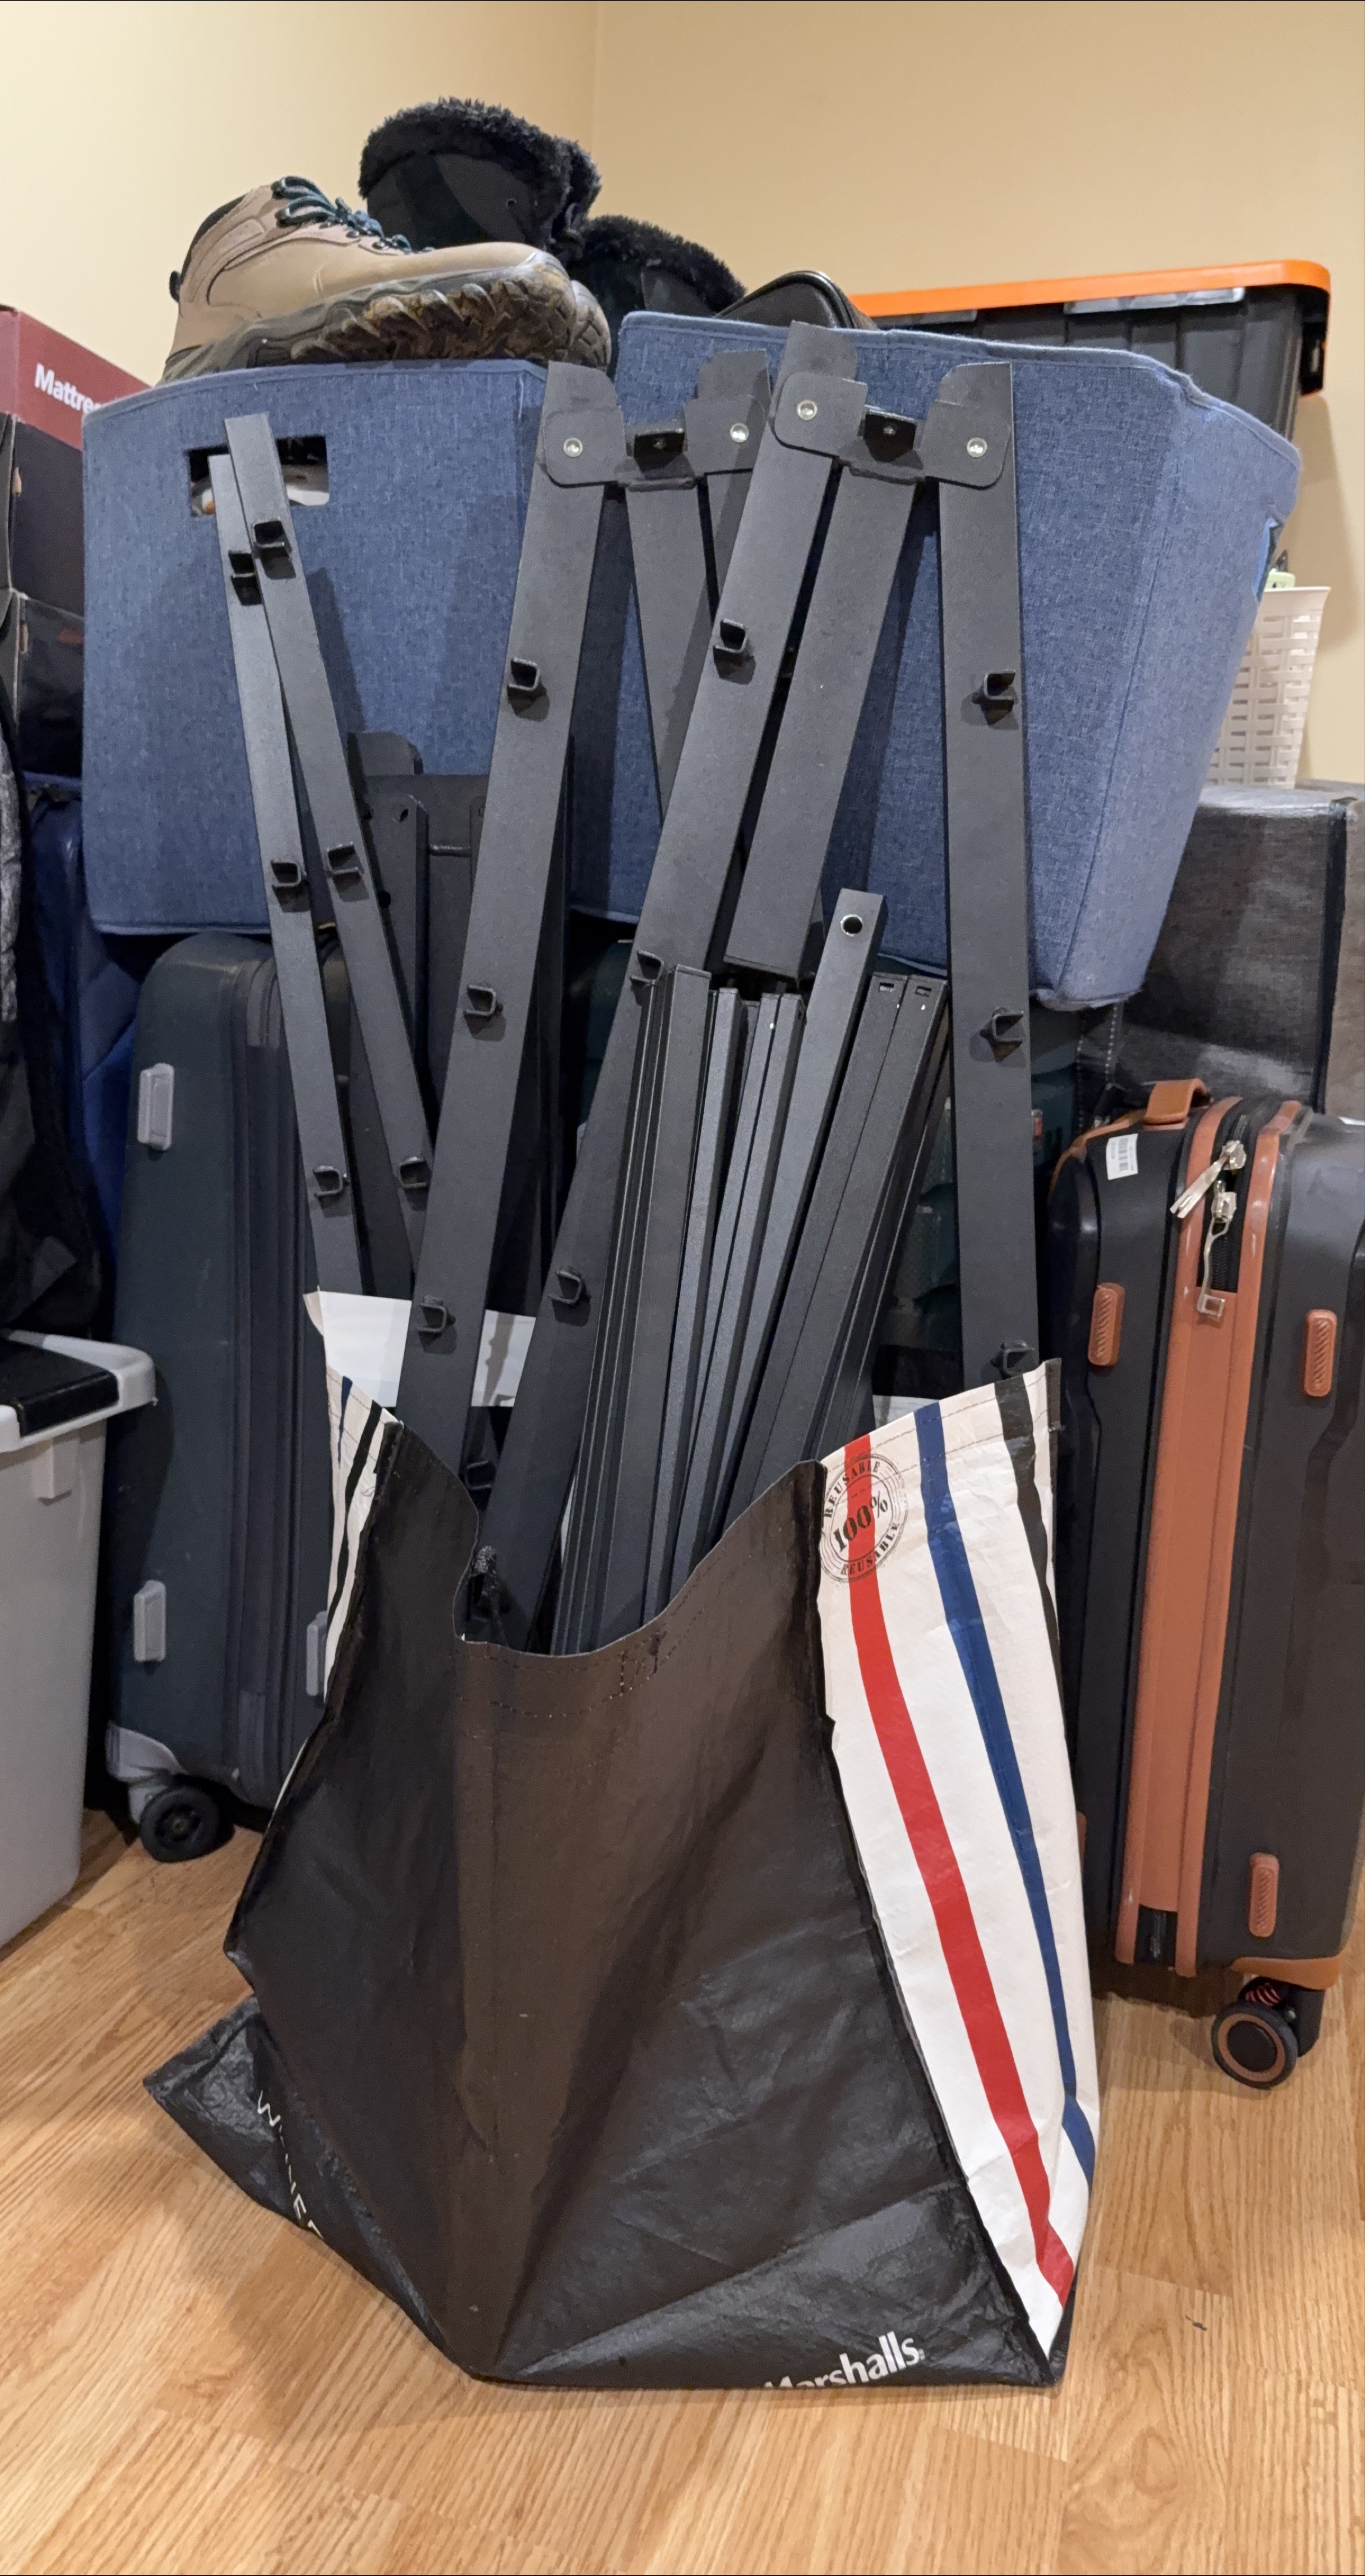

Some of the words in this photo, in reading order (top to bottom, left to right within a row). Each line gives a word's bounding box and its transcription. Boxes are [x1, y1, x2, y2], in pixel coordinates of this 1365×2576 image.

[824, 1461, 880, 1518] REUSABLE
[833, 1490, 889, 1553] 100%
[840, 1522, 900, 1575] REUSABLE
